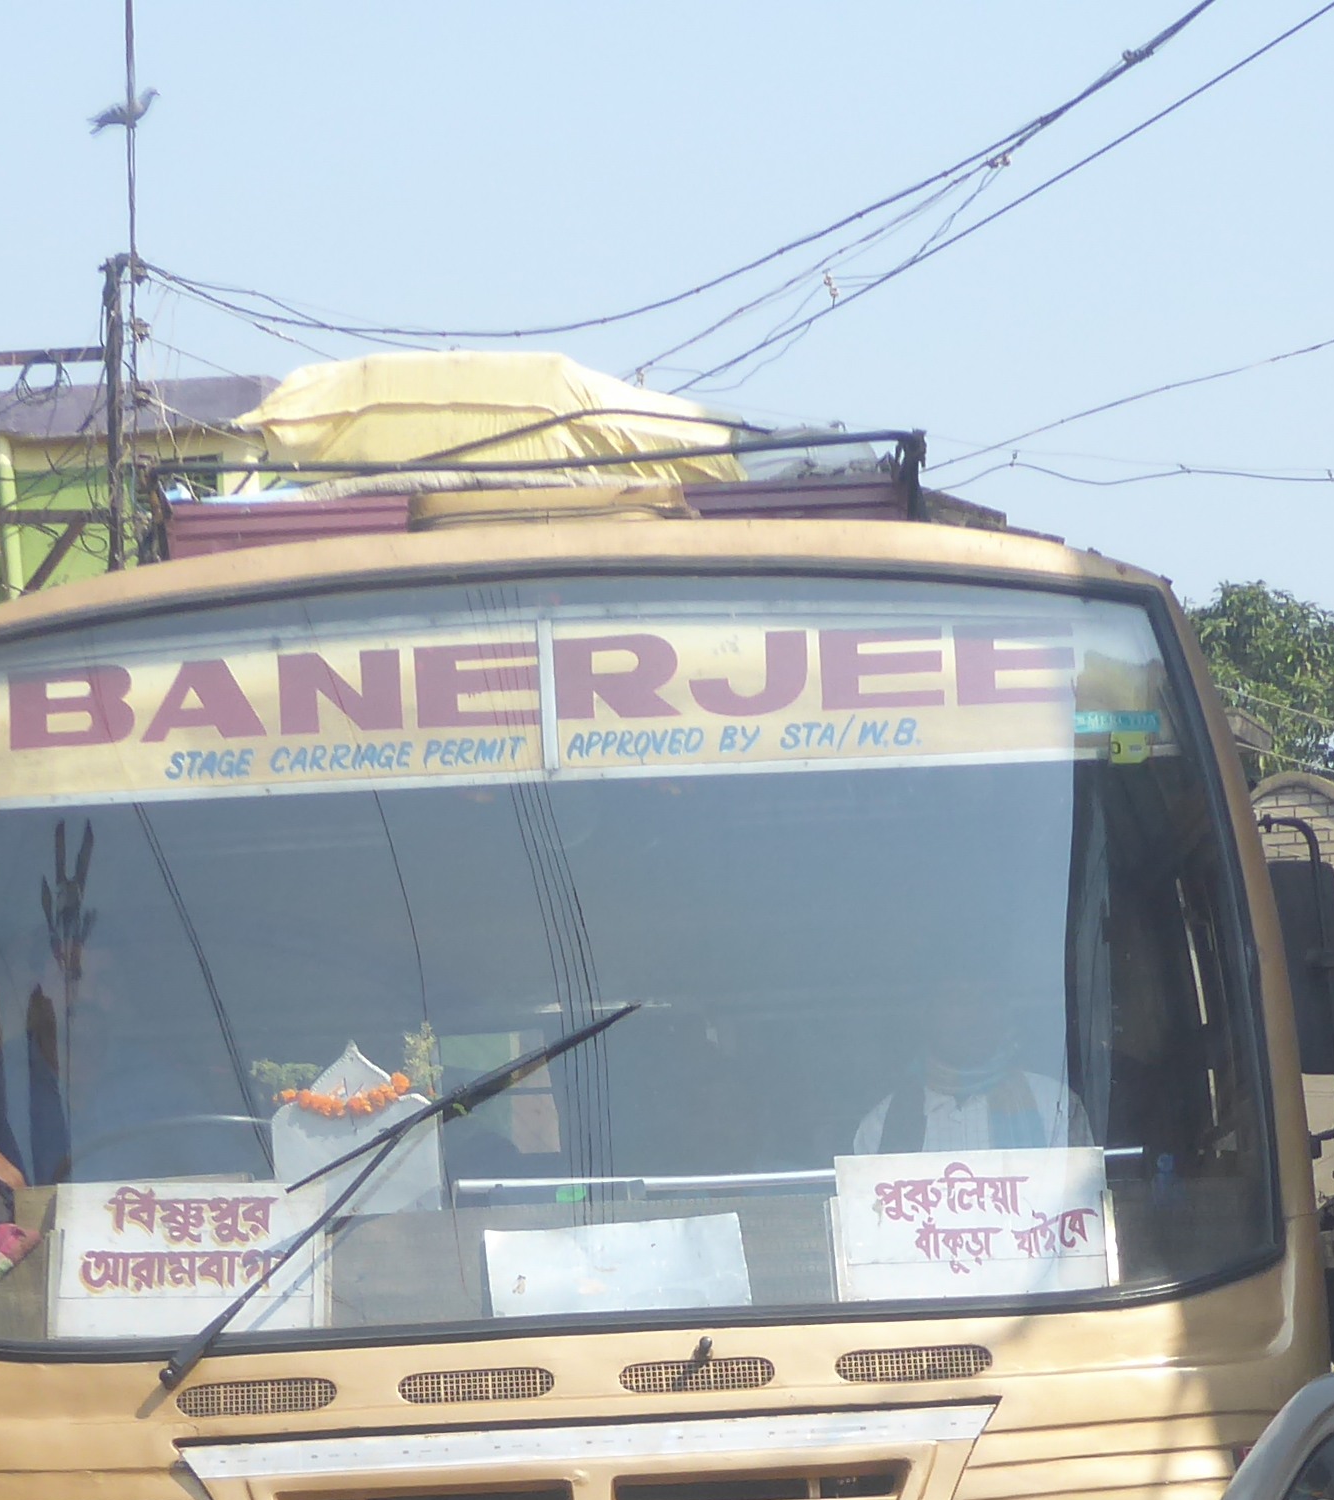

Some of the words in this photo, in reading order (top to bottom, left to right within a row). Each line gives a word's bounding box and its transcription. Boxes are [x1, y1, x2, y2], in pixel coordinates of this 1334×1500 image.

[9, 626, 1074, 750] BANERJEE
[166, 749, 253, 780] STAGE
[270, 740, 413, 774] CARRIAGE
[423, 736, 526, 765] PERMIT
[568, 727, 704, 760] APPROVED
[720, 725, 759, 752] BY
[104, 1186, 279, 1247] বিষ্ণুপুর
[875, 1162, 1029, 1222] পুরুলিয়া
[915, 1217, 1002, 1274] বাঁকুড়া
[1011, 1208, 1098, 1258] যাইবে
[80, 1249, 287, 1294] আরামবাগ
